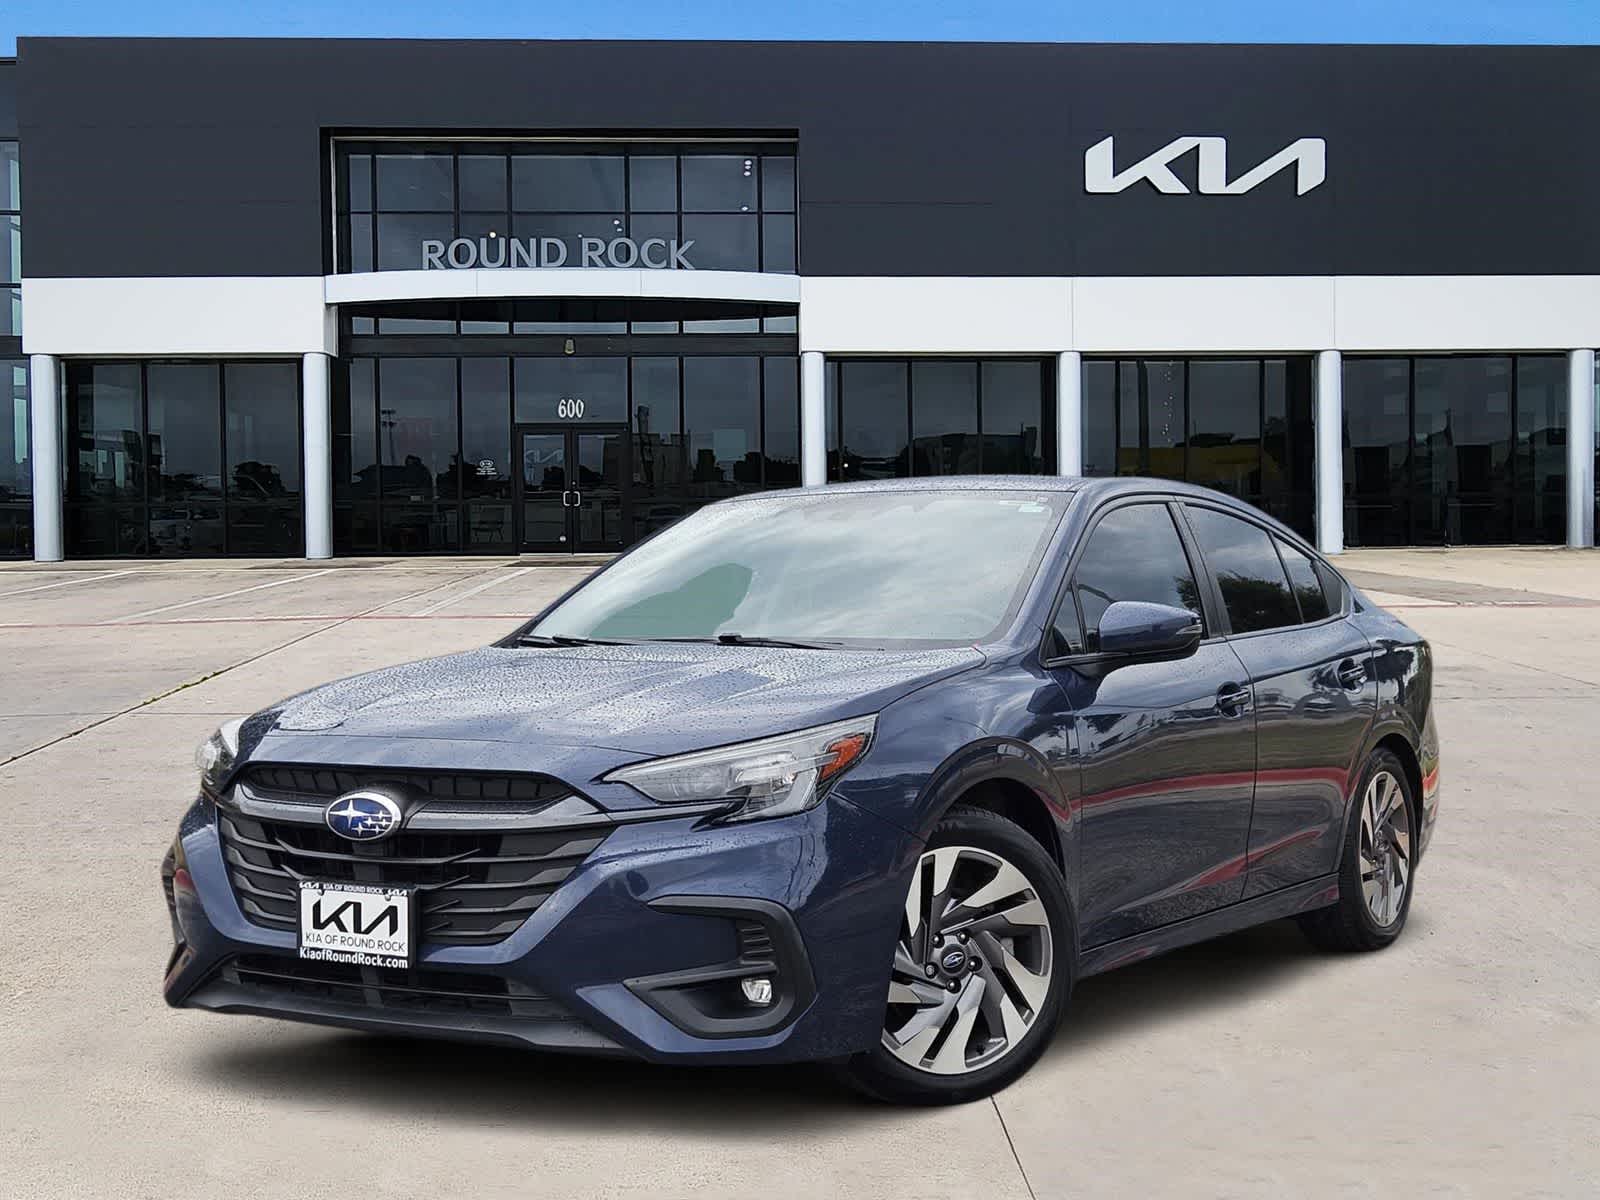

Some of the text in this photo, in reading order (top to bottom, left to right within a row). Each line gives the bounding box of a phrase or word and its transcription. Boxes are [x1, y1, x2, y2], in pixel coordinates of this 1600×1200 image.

[1085, 135, 1326, 196] KIA
[422, 237, 696, 270] ROUND ROCK
[558, 399, 584, 418] 600
[344, 885, 366, 893] ROUND
[367, 887, 384, 895] ROCK
[312, 899, 398, 937] KIA
[305, 931, 406, 952] KIA OF ROUND ROCK
[299, 947, 408, 969] KiaofRoundRock.com
